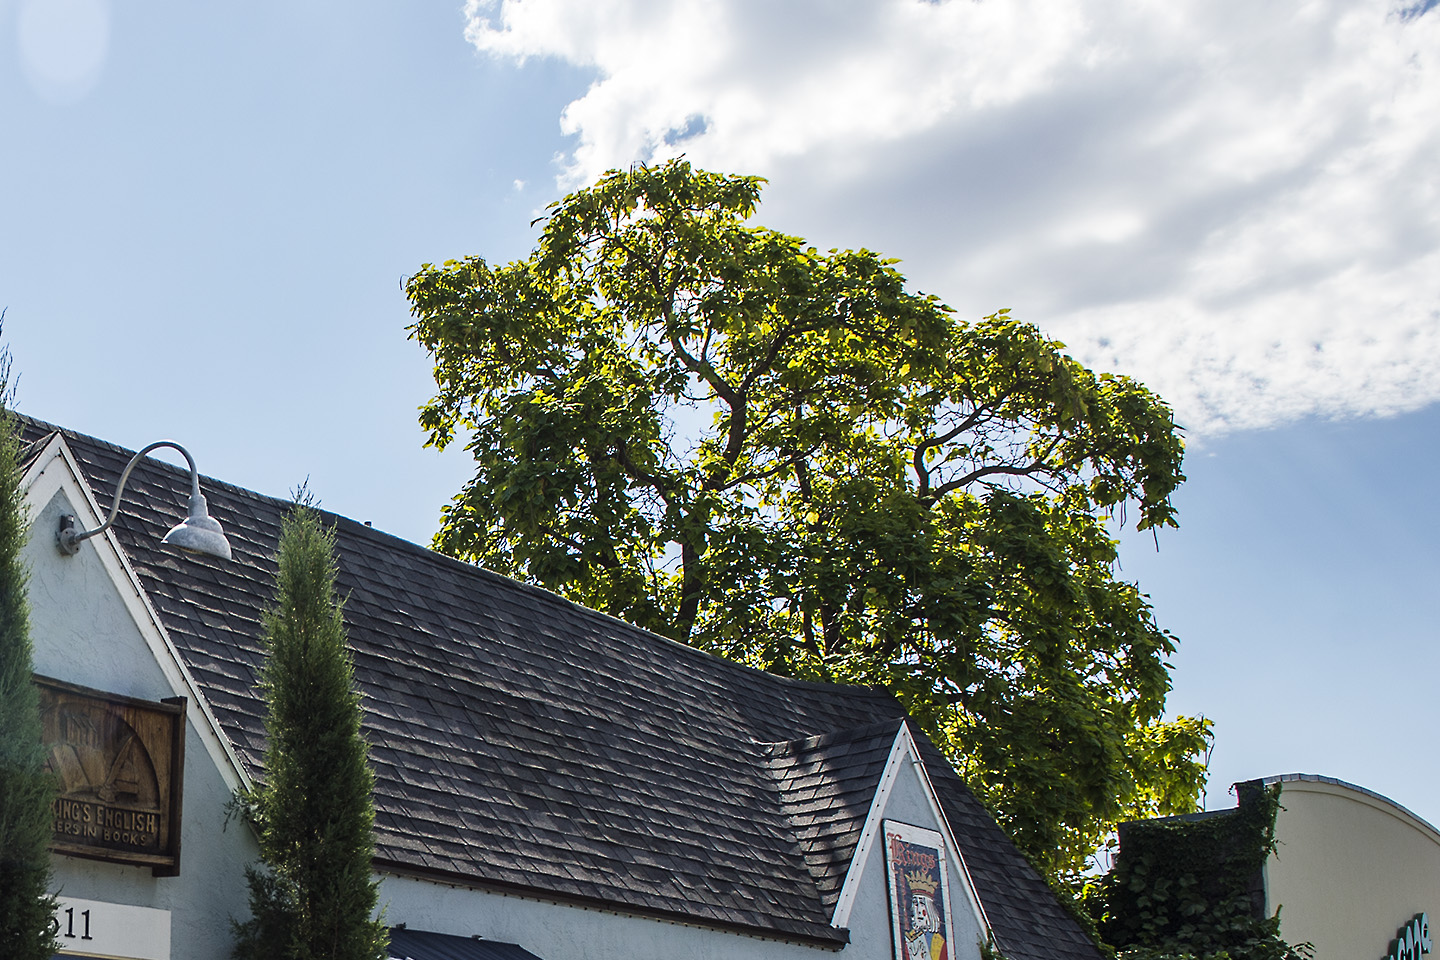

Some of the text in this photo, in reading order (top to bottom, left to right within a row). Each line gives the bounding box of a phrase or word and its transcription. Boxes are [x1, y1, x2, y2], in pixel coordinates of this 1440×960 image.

[97, 806, 155, 833] ENGLISH
[49, 820, 147, 846] LERS IN BOOKS
